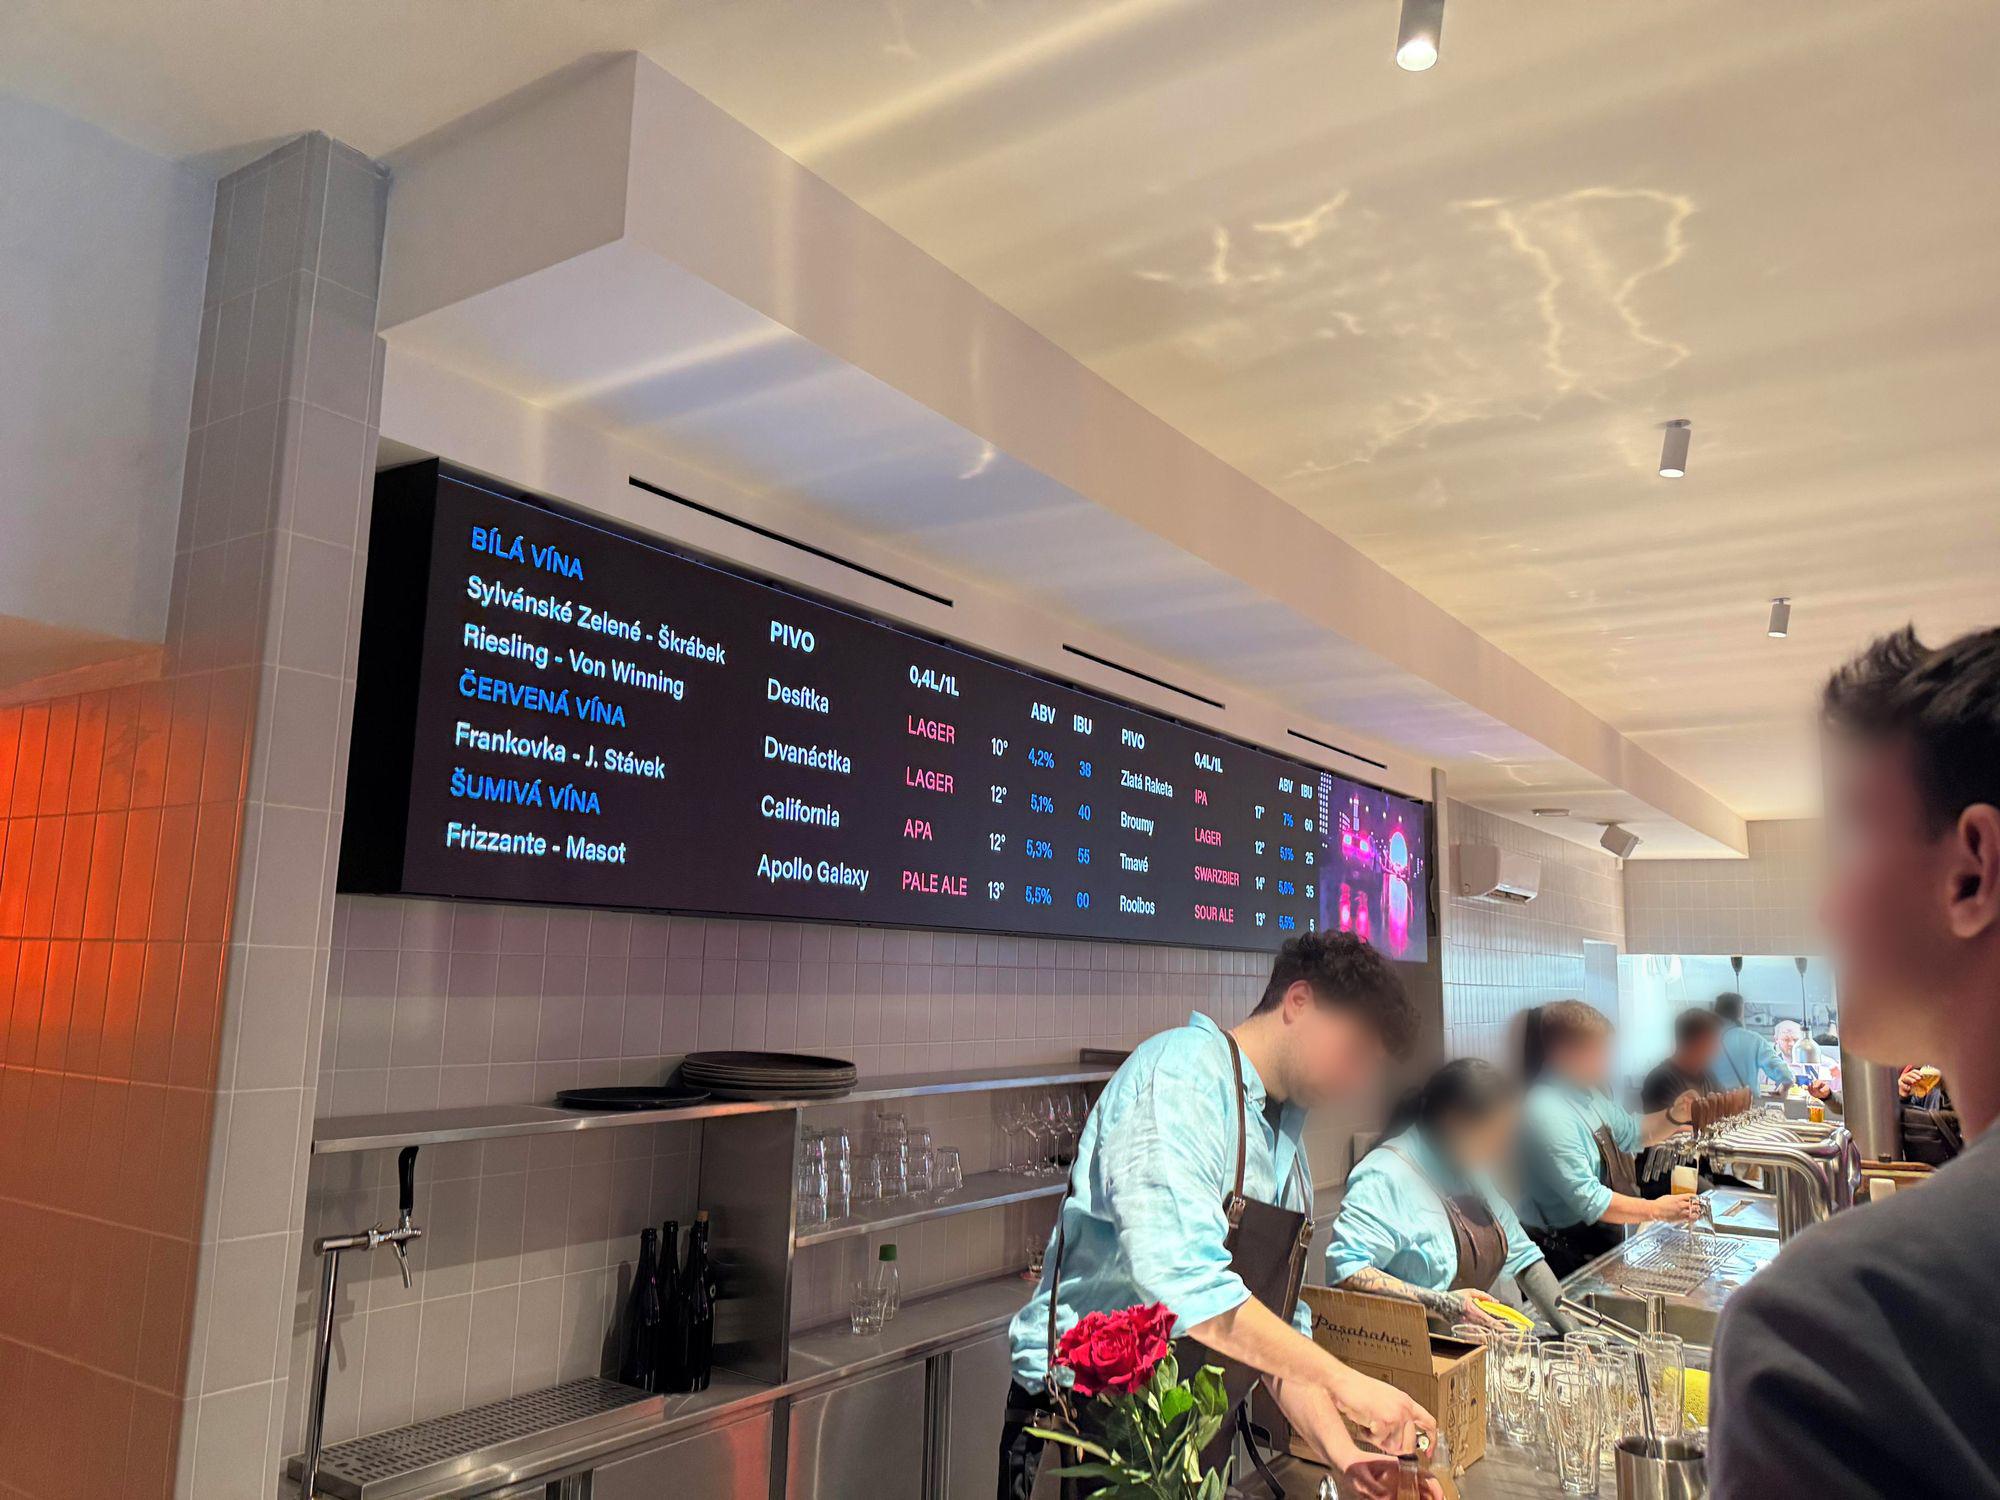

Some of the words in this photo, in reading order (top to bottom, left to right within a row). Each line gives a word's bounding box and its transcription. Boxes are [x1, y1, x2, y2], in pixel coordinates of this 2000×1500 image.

[471, 525, 525, 564] BÍLÁ
[532, 544, 584, 581] VÍNA
[467, 575, 572, 624] Sylvánské
[577, 605, 641, 642] Zelené
[658, 623, 726, 665] Škrábek
[463, 623, 548, 669] Riesling
[569, 648, 606, 678] Von
[612, 659, 684, 700] Winning
[770, 620, 815, 653] PIVO
[909, 665, 960, 697] 0,4L/1L
[1031, 702, 1056, 724] ABV
[1073, 714, 1093, 735] IBU
[459, 668, 570, 717] ČERVENÁ
[577, 696, 626, 728] VÍNA
[767, 678, 829, 714] Desítka
[908, 715, 955, 744] LAGER
[1028, 748, 1055, 769] 4,2%
[1079, 761, 1092, 778] 38
[455, 721, 566, 763] Frankovka
[585, 745, 598, 769] J.
[604, 748, 665, 779] Stávek
[764, 735, 851, 774] Dvanáctka
[906, 766, 954, 794] LAGER
[1030, 794, 1054, 814] 5,1%
[1078, 805, 1091, 821] 40
[1122, 729, 1145, 750] PIVO
[1279, 777, 1293, 793] ABV
[1301, 784, 1312, 799] IBU
[450, 767, 542, 808] ŠUMIVÁ
[549, 782, 600, 815] VÍNA
[1121, 770, 1143, 790] Zlatá
[1145, 777, 1173, 798] Raketa
[1195, 789, 1208, 806] IPA
[1304, 819, 1313, 832] 60
[446, 821, 546, 857] Frizzante
[566, 836, 626, 864] Masot
[761, 795, 840, 828] California
[904, 819, 933, 841] APA
[1026, 839, 1053, 859] 5,3%
[1078, 848, 1090, 864] 55
[1121, 811, 1154, 836] Broumy
[1195, 828, 1222, 846] LAGER
[1305, 852, 1314, 865] 25
[757, 854, 812, 883] Apollo
[817, 861, 869, 891] Galaxy
[902, 870, 939, 893] PALE
[941, 875, 968, 896] ALE
[1025, 885, 1052, 905] 5,5%
[1077, 892, 1090, 908] 60
[1120, 853, 1149, 873] Tmavé
[1195, 866, 1240, 886] SWARZBIER
[1306, 885, 1314, 898] 35
[1120, 895, 1156, 915] Rooibos
[1195, 905, 1218, 922] SOUR
[1219, 908, 1234, 923] ALE
[1309, 919, 1315, 933] 5
